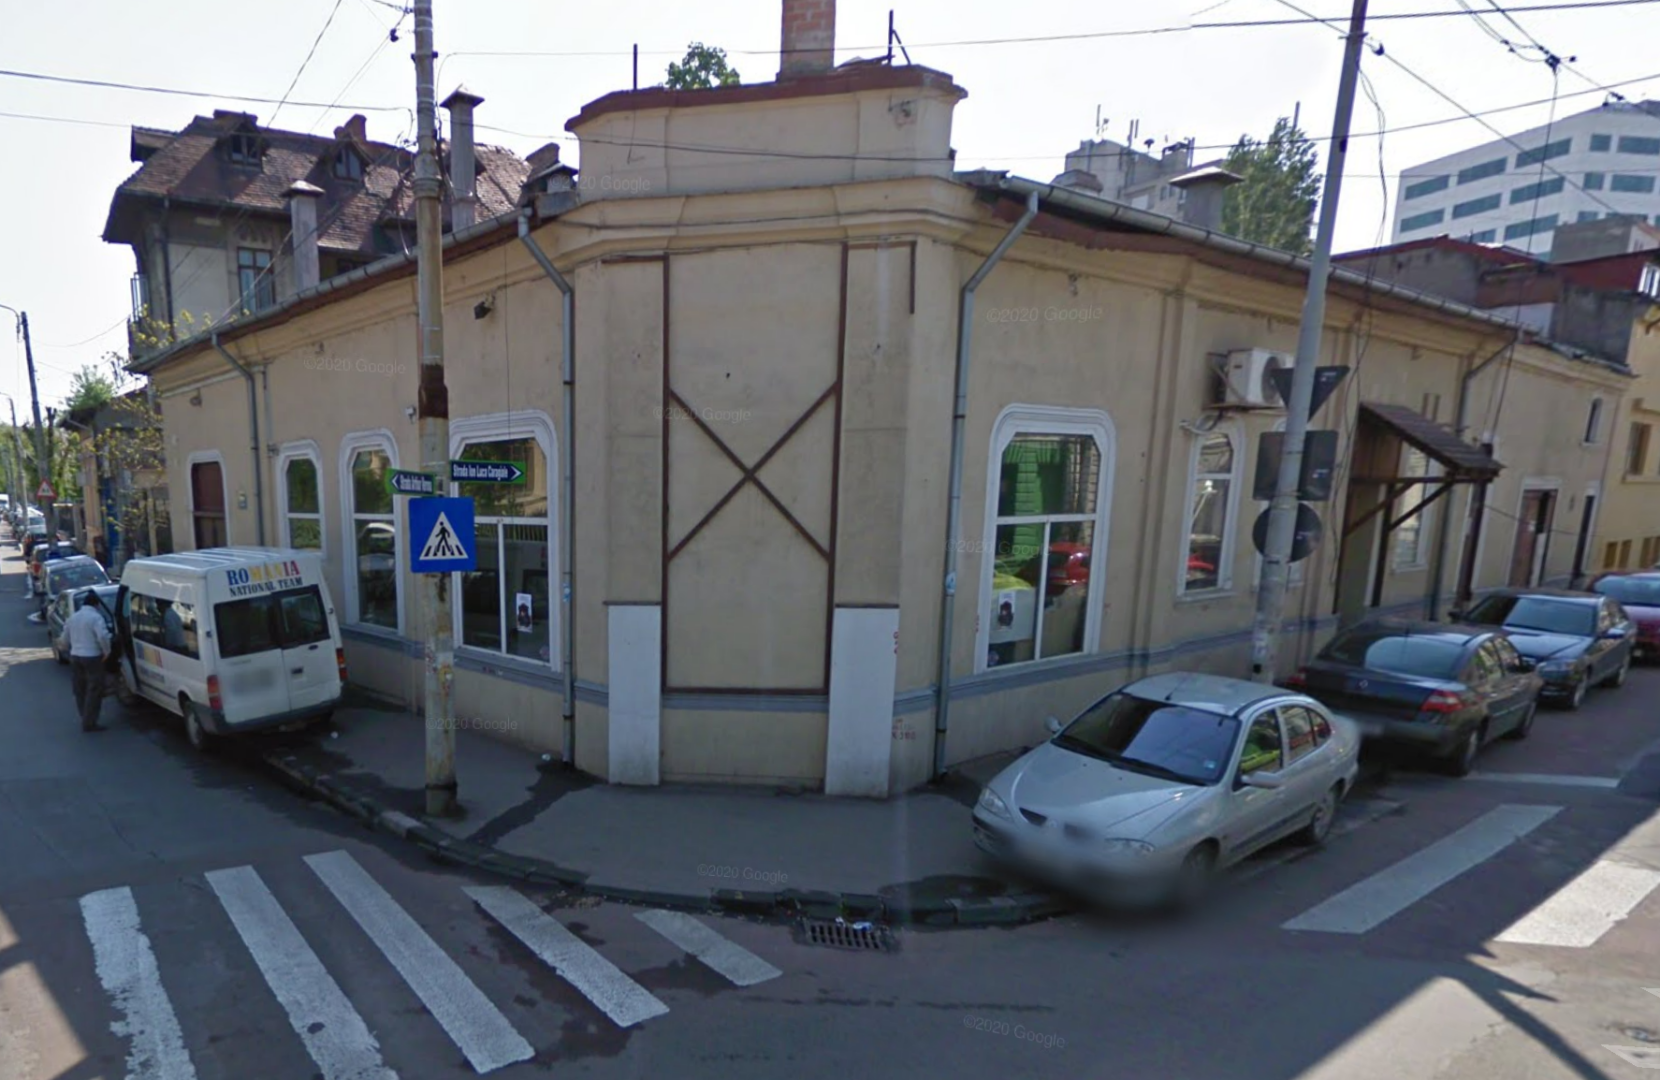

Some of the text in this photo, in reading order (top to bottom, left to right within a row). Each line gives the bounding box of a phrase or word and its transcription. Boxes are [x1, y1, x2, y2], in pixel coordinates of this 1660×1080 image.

[476, 465, 487, 478] Luca
[229, 576, 303, 597] NATIONAL TEAM
